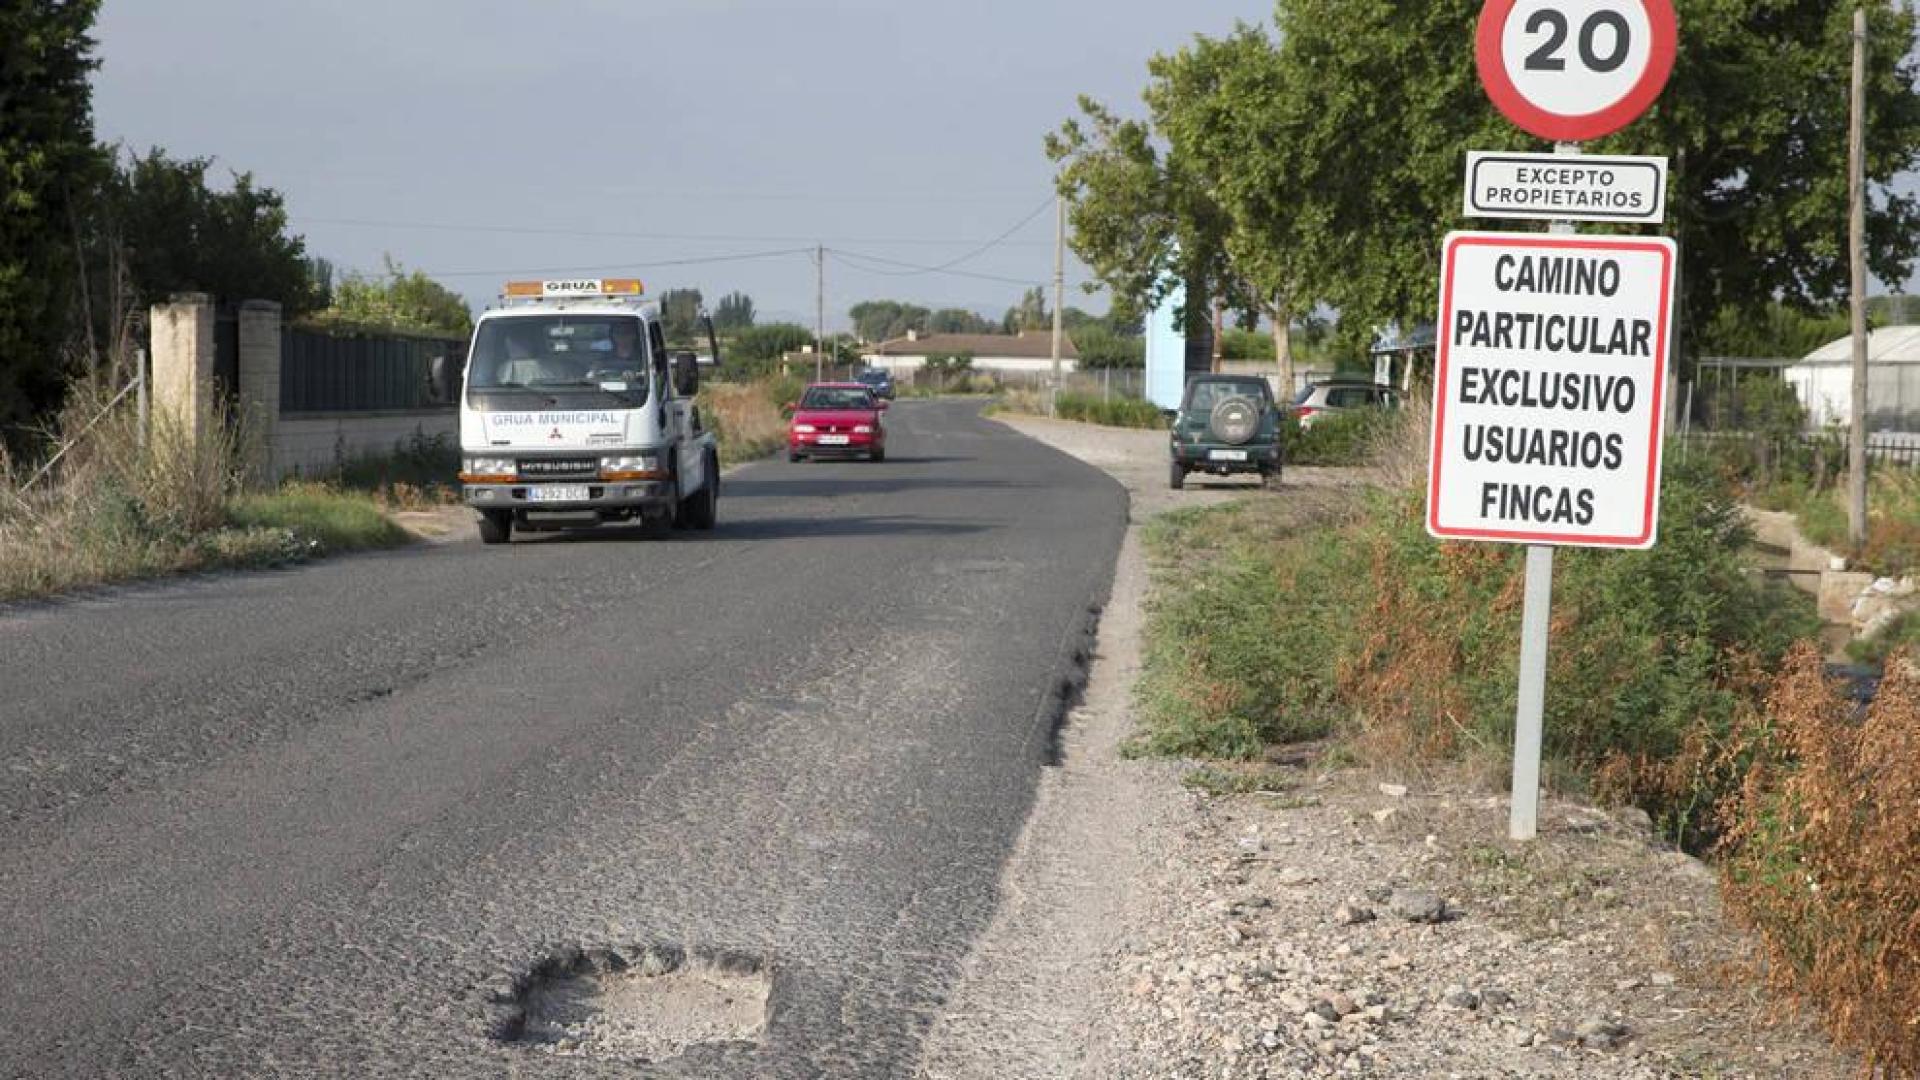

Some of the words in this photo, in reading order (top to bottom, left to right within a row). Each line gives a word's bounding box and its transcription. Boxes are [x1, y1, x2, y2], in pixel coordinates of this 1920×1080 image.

[1524, 8, 1631, 73] 20
[1486, 187, 1642, 208] PROPIETARIOS
[1516, 168, 1615, 186] EXCEPTO
[546, 281, 597, 290] GRUA
[1495, 253, 1620, 297] CAMINO
[1454, 309, 1651, 357] PARTICULAR
[1459, 367, 1636, 414] EXCLUSIVO
[492, 414, 533, 426] GRUA
[538, 412, 619, 425] MUNICIPAL
[1463, 424, 1624, 470] USUARIOS
[1481, 482, 1595, 526] FINCAS
